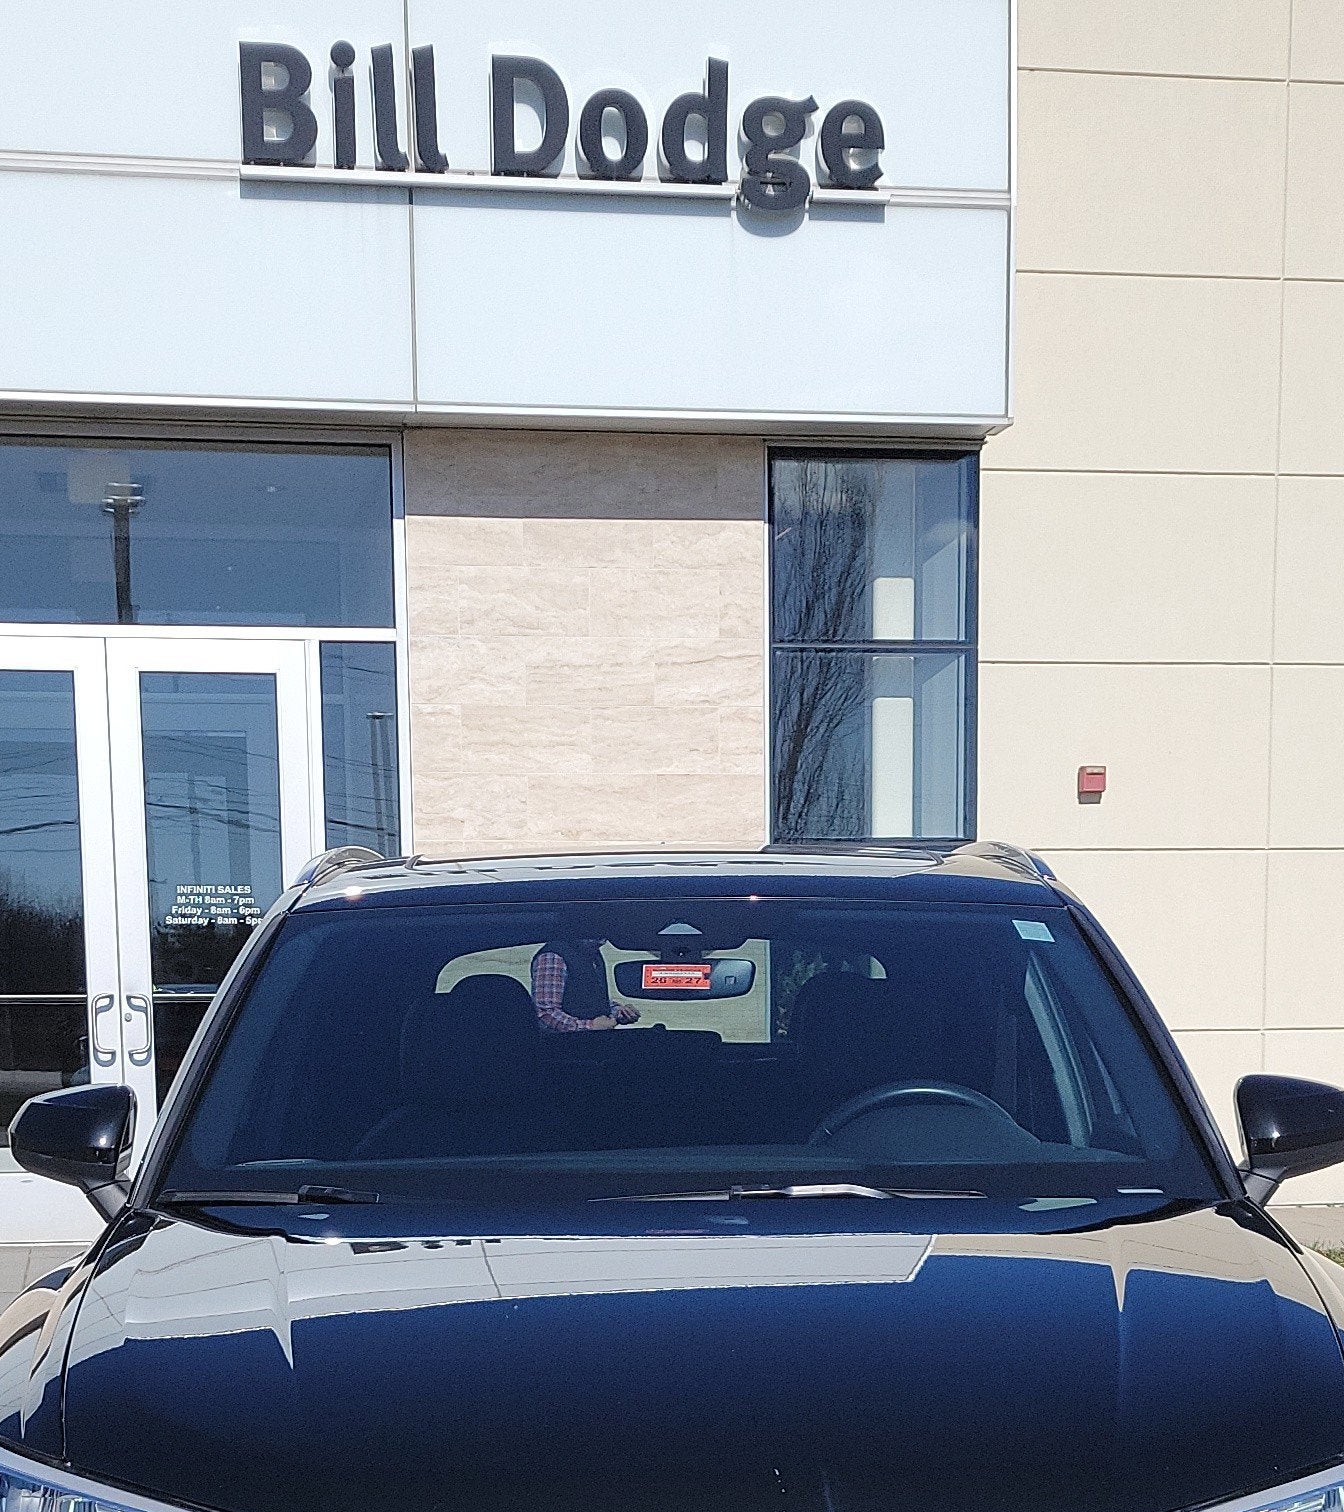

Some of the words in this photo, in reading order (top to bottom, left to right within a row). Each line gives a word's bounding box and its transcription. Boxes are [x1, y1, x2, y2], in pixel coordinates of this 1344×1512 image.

[238, 40, 449, 173] Bill
[490, 54, 886, 211] Dodge
[176, 885, 216, 894] INFINITI
[217, 885, 252, 894] SALES
[176, 895, 203, 904] M-TH
[204, 895, 226, 904] 8am
[232, 895, 255, 906] 7pm
[171, 905, 203, 915] Friday
[210, 905, 231, 915] 8am
[238, 905, 261, 916] 6pm
[165, 915, 209, 926] Saturday
[217, 915, 238, 925] 8am
